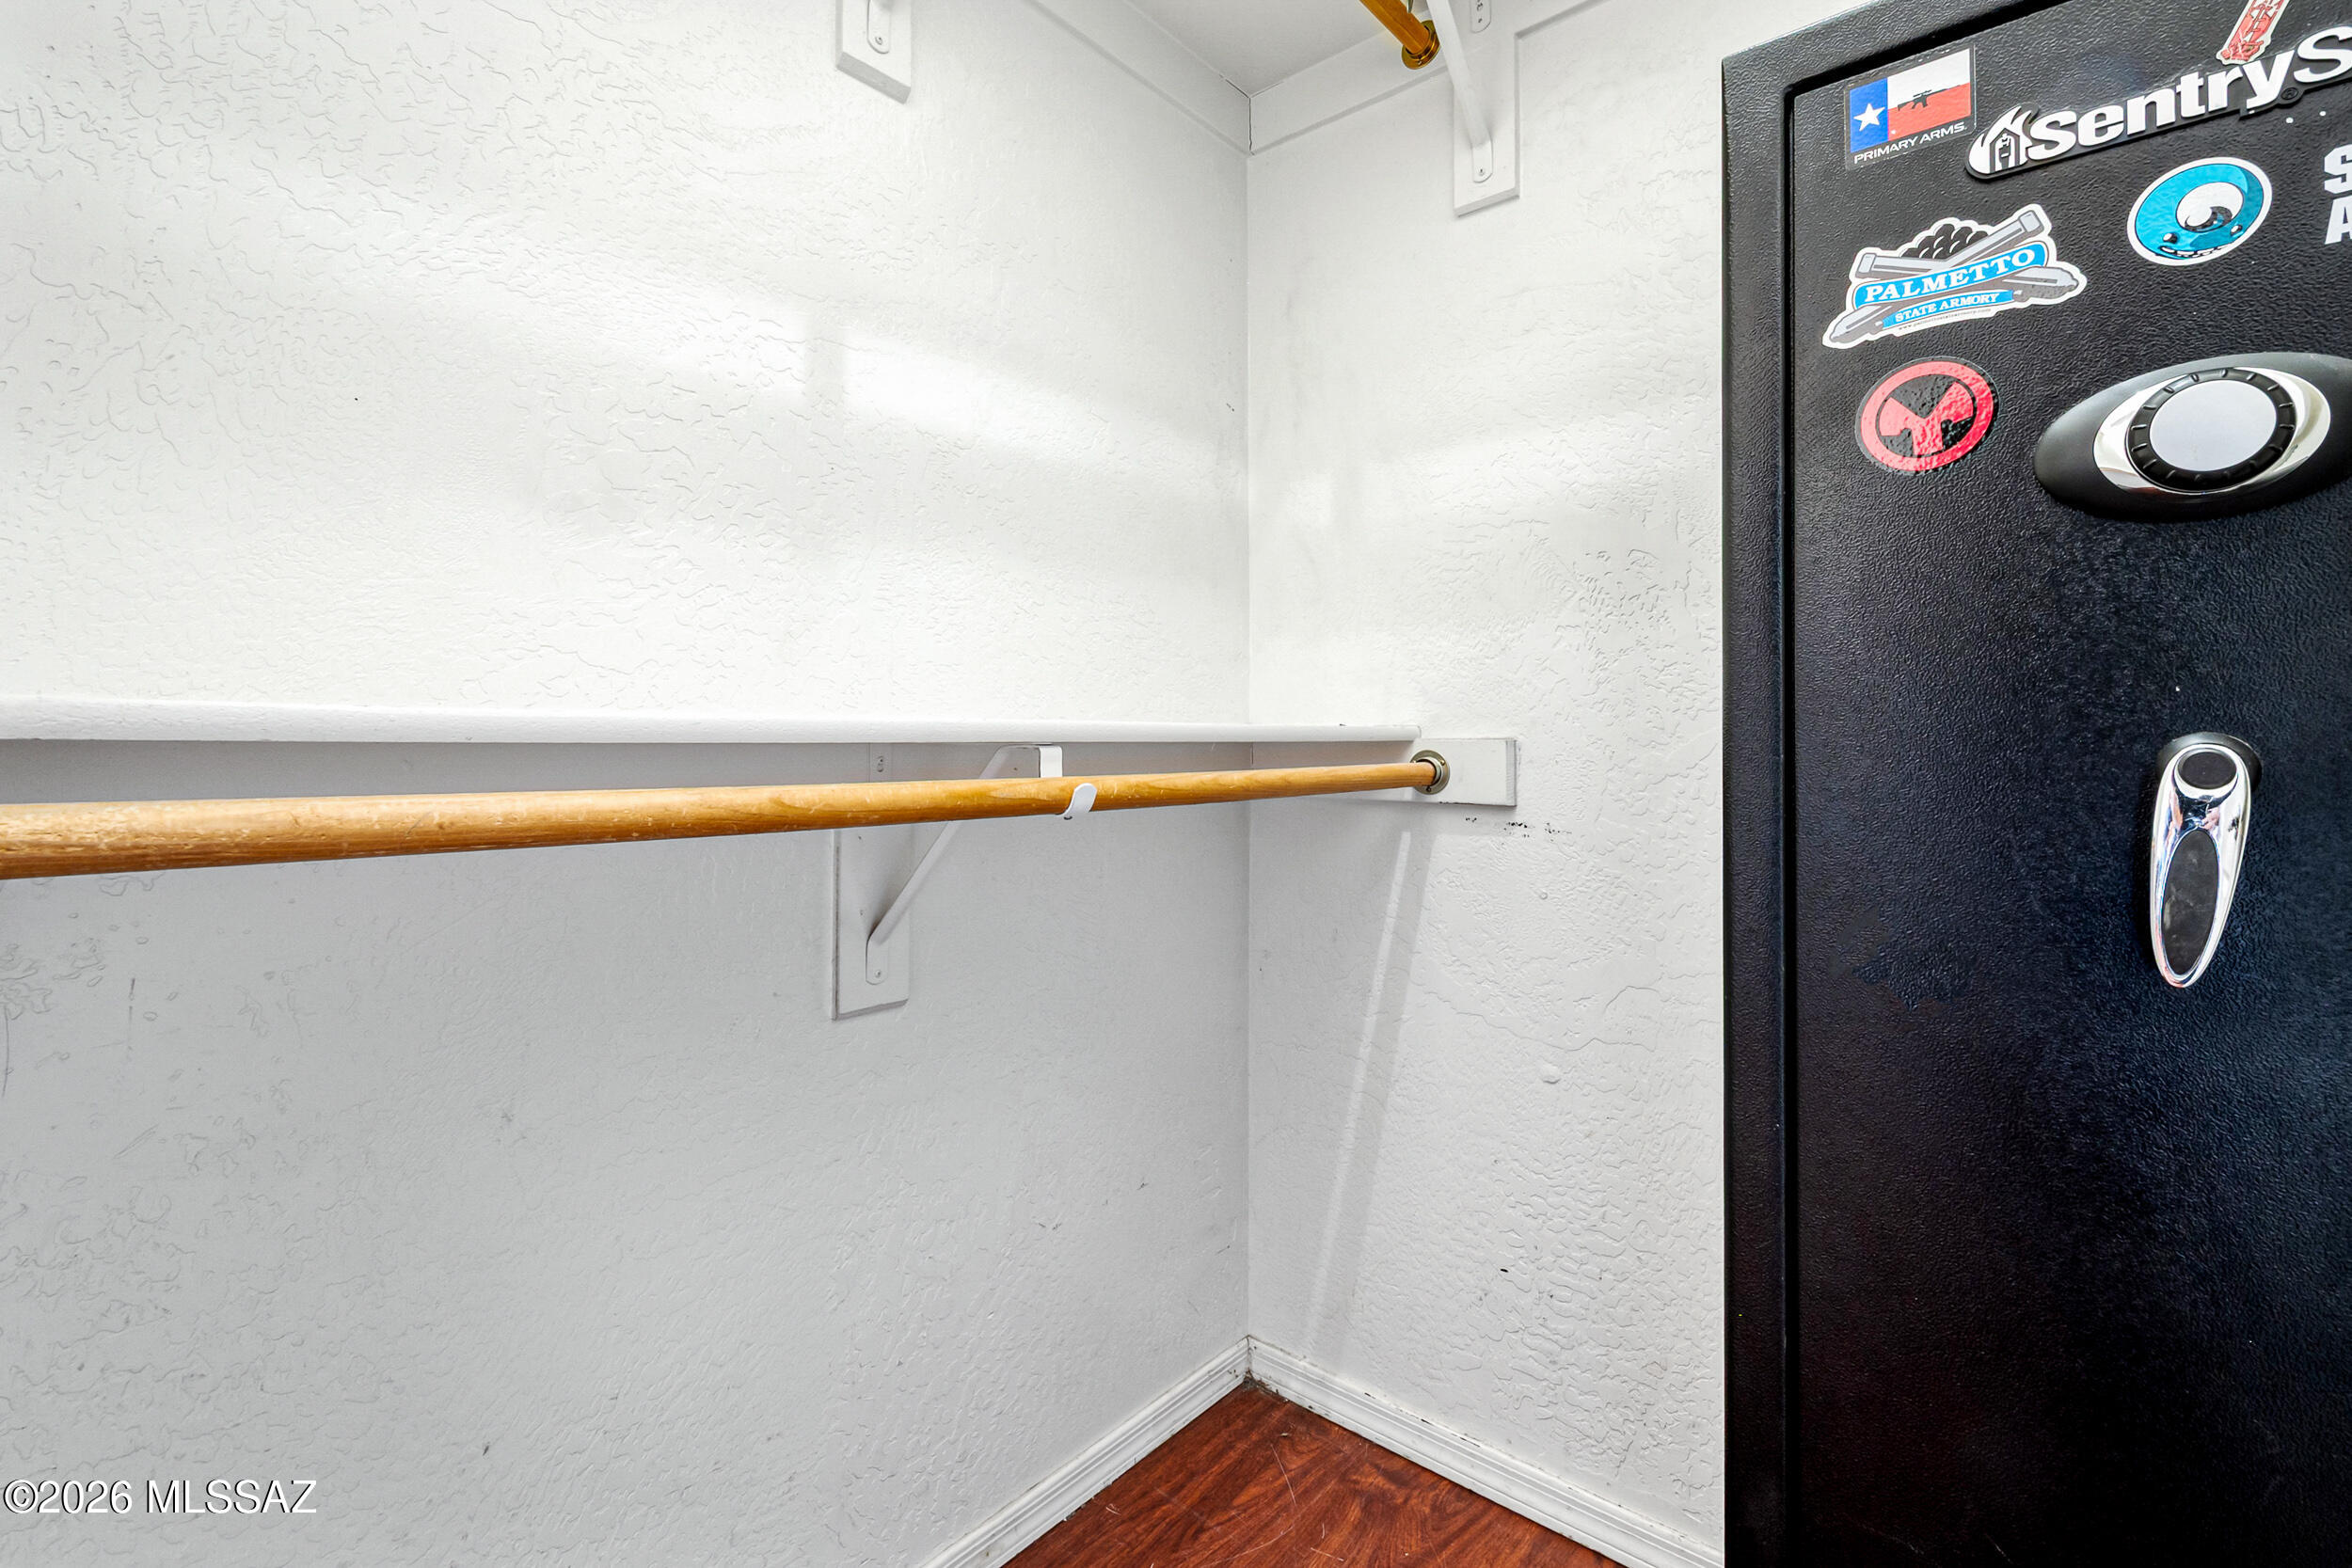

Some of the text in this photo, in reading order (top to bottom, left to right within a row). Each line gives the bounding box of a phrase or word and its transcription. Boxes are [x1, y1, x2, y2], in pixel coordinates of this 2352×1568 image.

[1853, 136, 1918, 164] PRIMARY
[1865, 248, 2037, 303] PALMETTO
[1895, 303, 1938, 322] STATE
[1939, 293, 2000, 311] ARMORY
